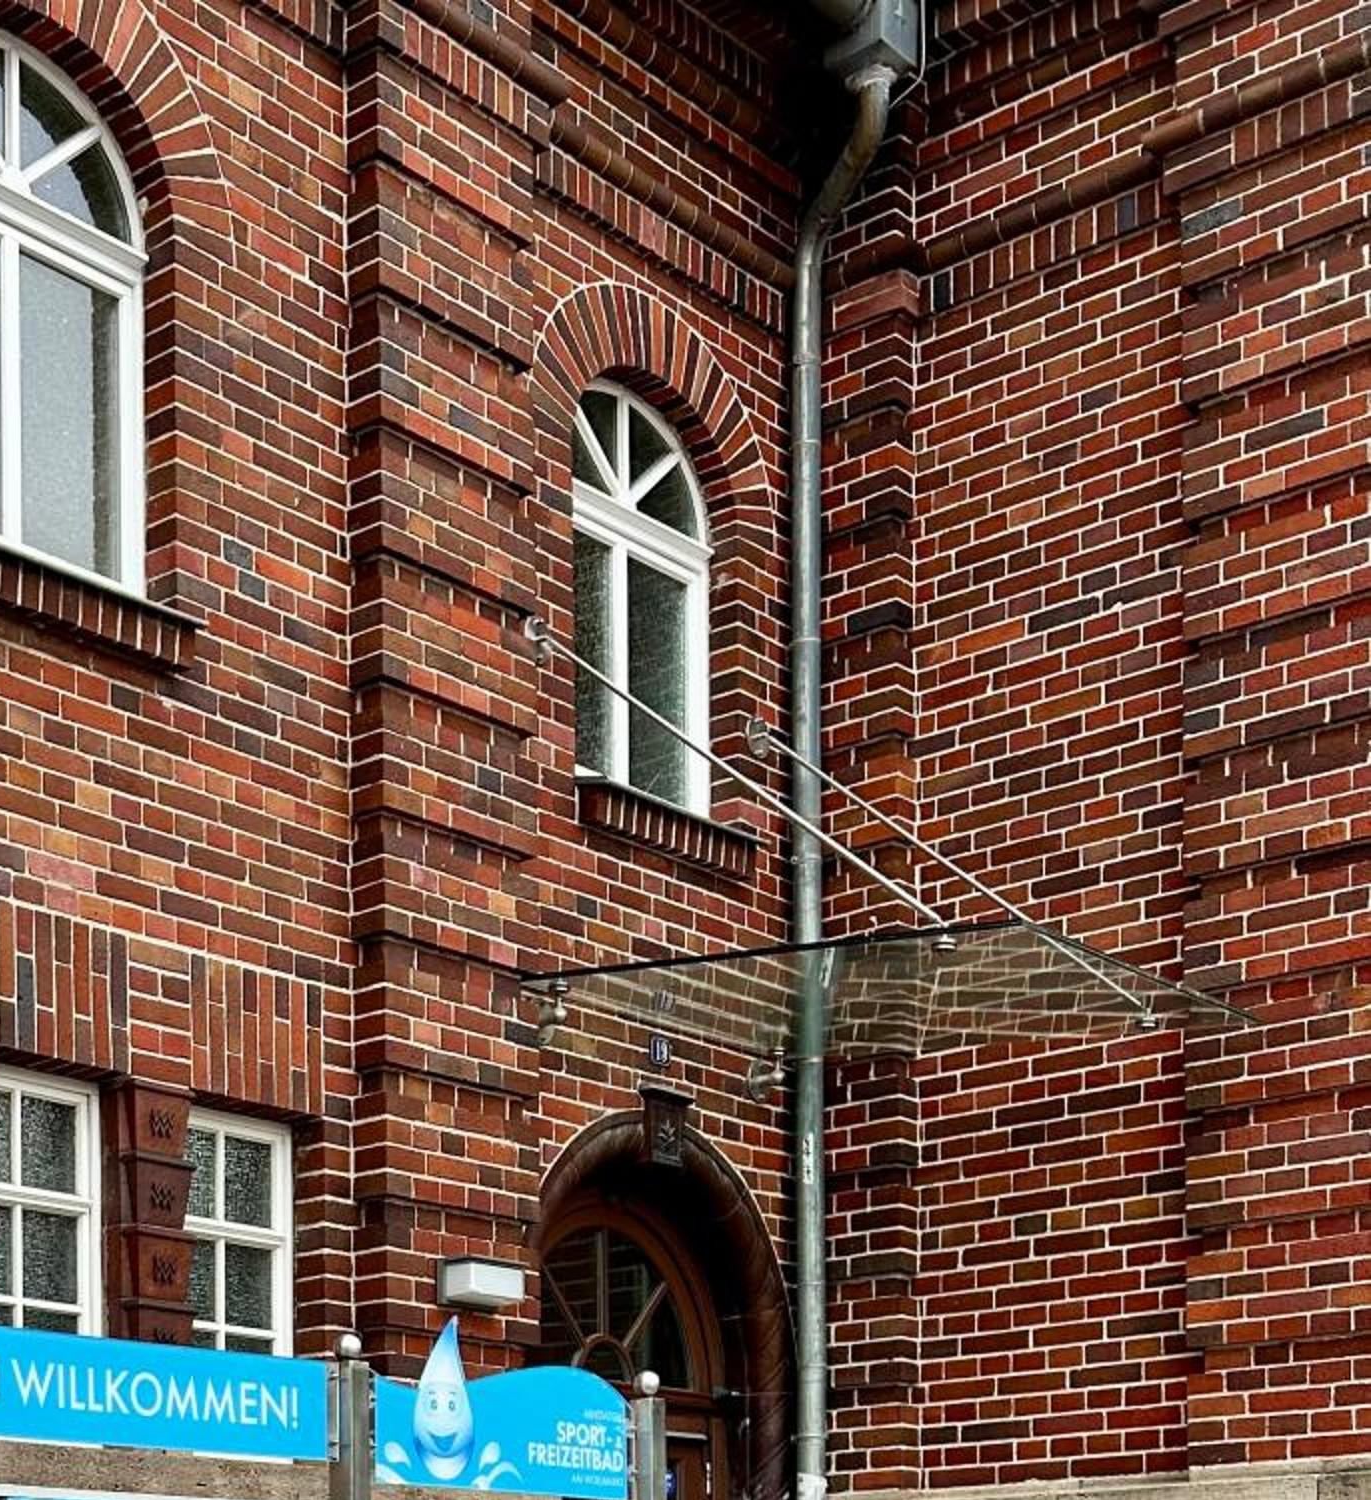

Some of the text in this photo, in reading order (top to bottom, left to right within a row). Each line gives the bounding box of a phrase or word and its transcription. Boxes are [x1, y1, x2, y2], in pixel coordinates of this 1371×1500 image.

[11, 1358, 300, 1429] WILLKOMMEN!
[556, 1420, 613, 1447] SPORT-
[528, 1442, 624, 1472] FREIZEITBAD
